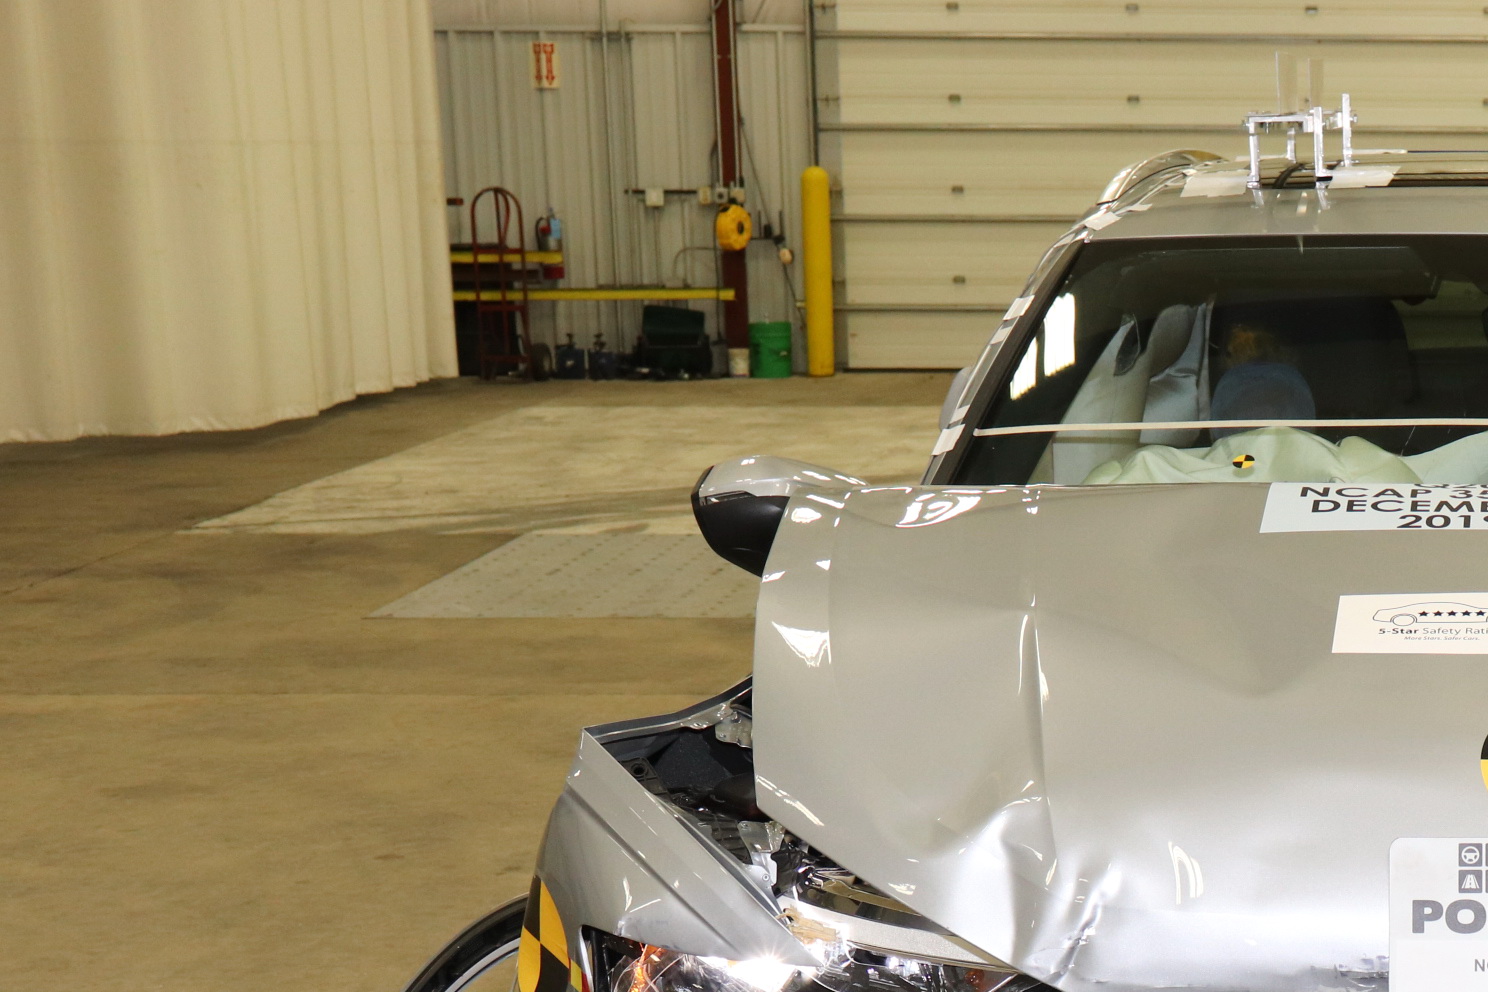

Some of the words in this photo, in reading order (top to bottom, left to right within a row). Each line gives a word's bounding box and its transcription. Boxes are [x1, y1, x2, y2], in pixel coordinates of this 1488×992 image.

[1300, 486, 1432, 499] NCAP
[1378, 627, 1419, 635] 5-Star
[1422, 627, 1461, 636] Safety
